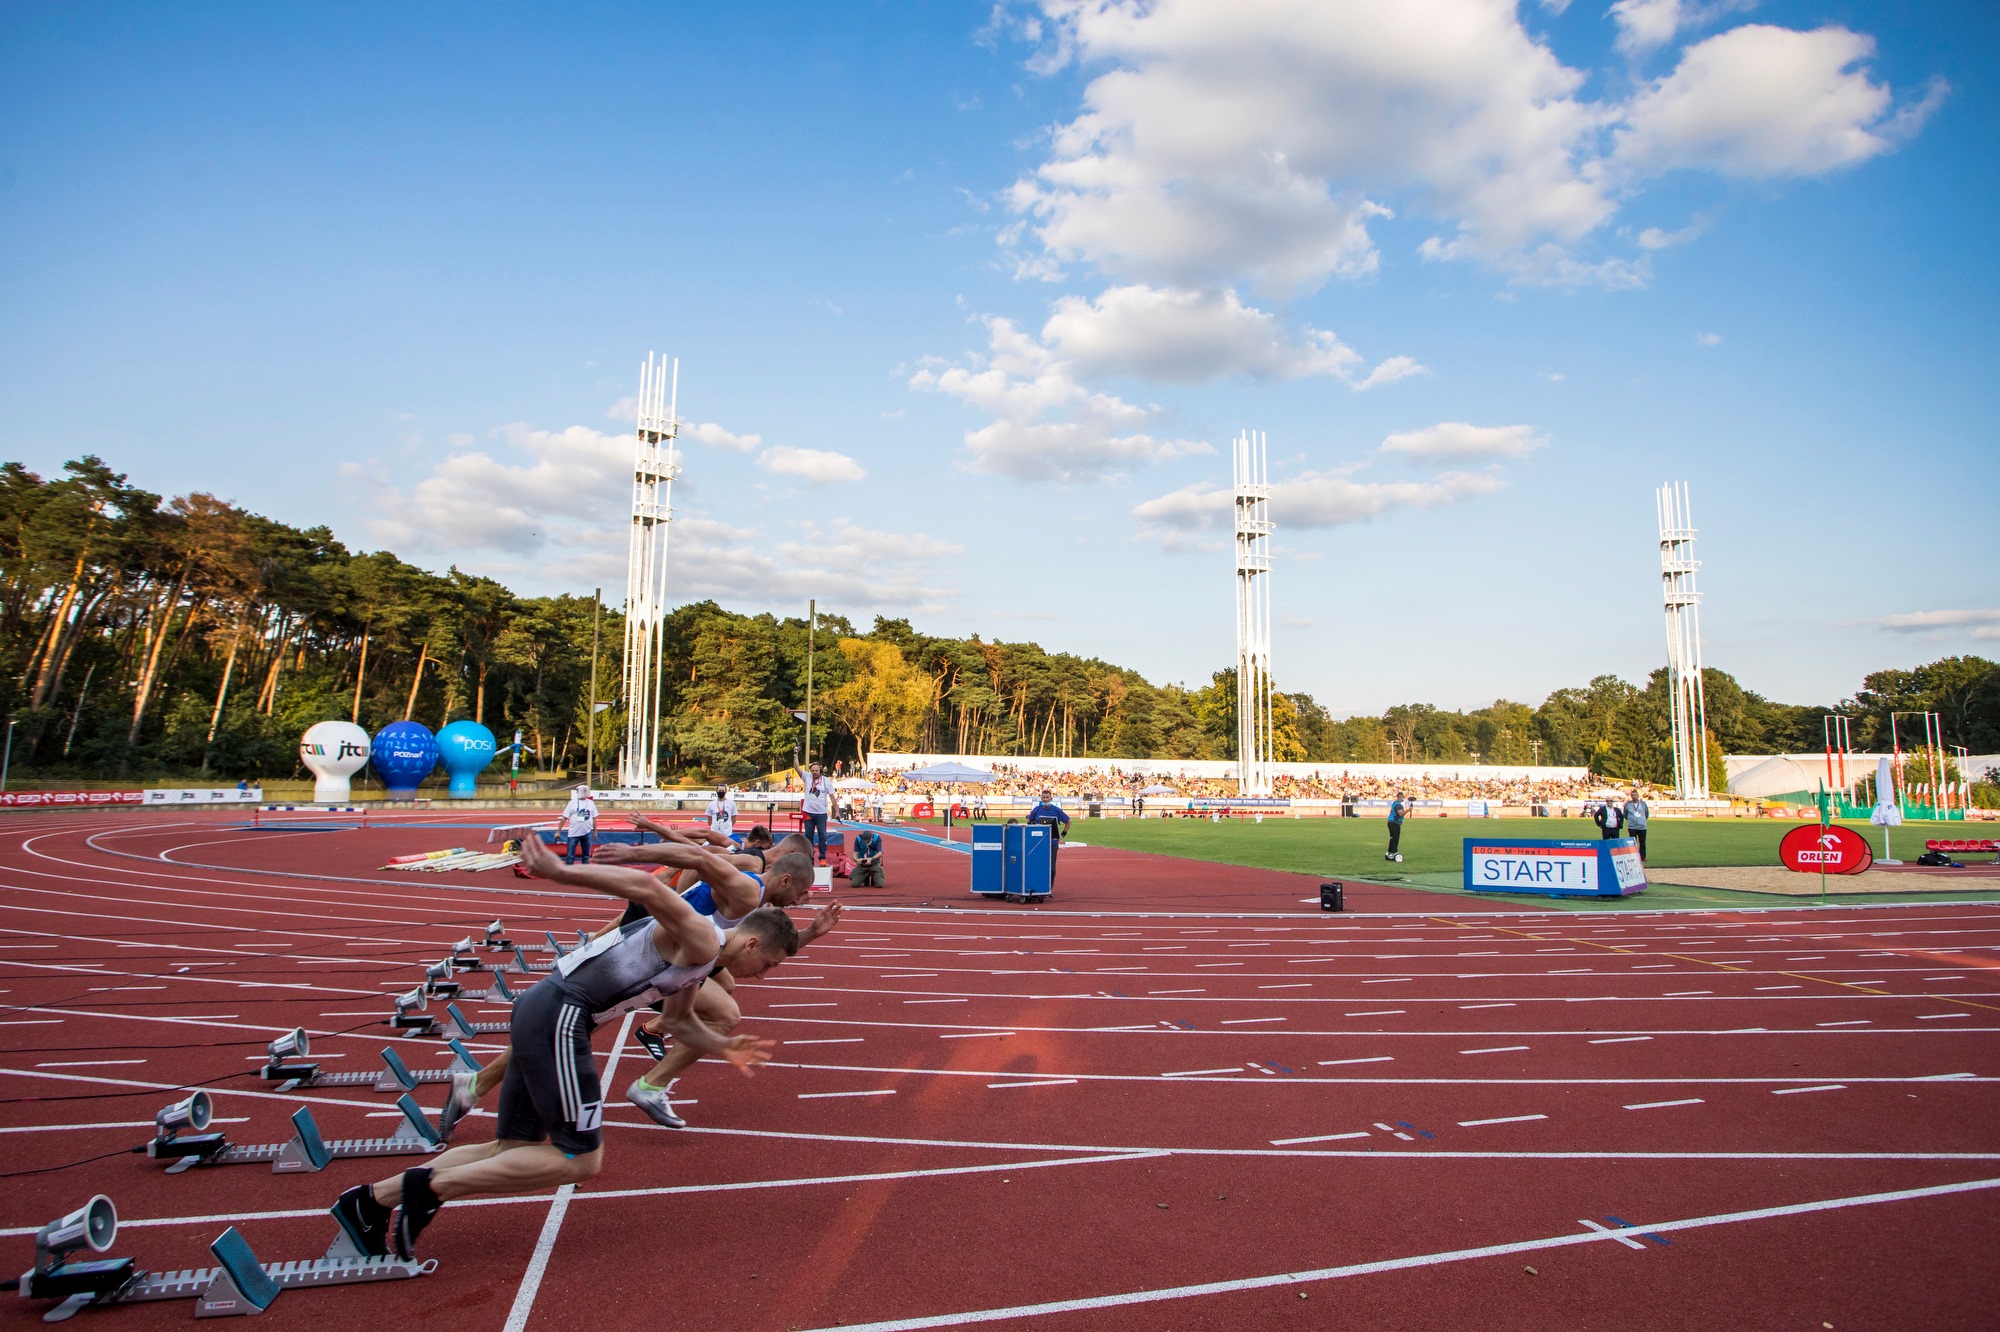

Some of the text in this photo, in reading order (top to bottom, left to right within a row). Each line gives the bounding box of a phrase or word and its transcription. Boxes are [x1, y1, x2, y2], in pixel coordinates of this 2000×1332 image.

[337, 740, 362, 761] jtc
[1800, 853, 1839, 862] ORLEN
[1484, 859, 1587, 884] START !
[584, 1105, 598, 1129] 7
